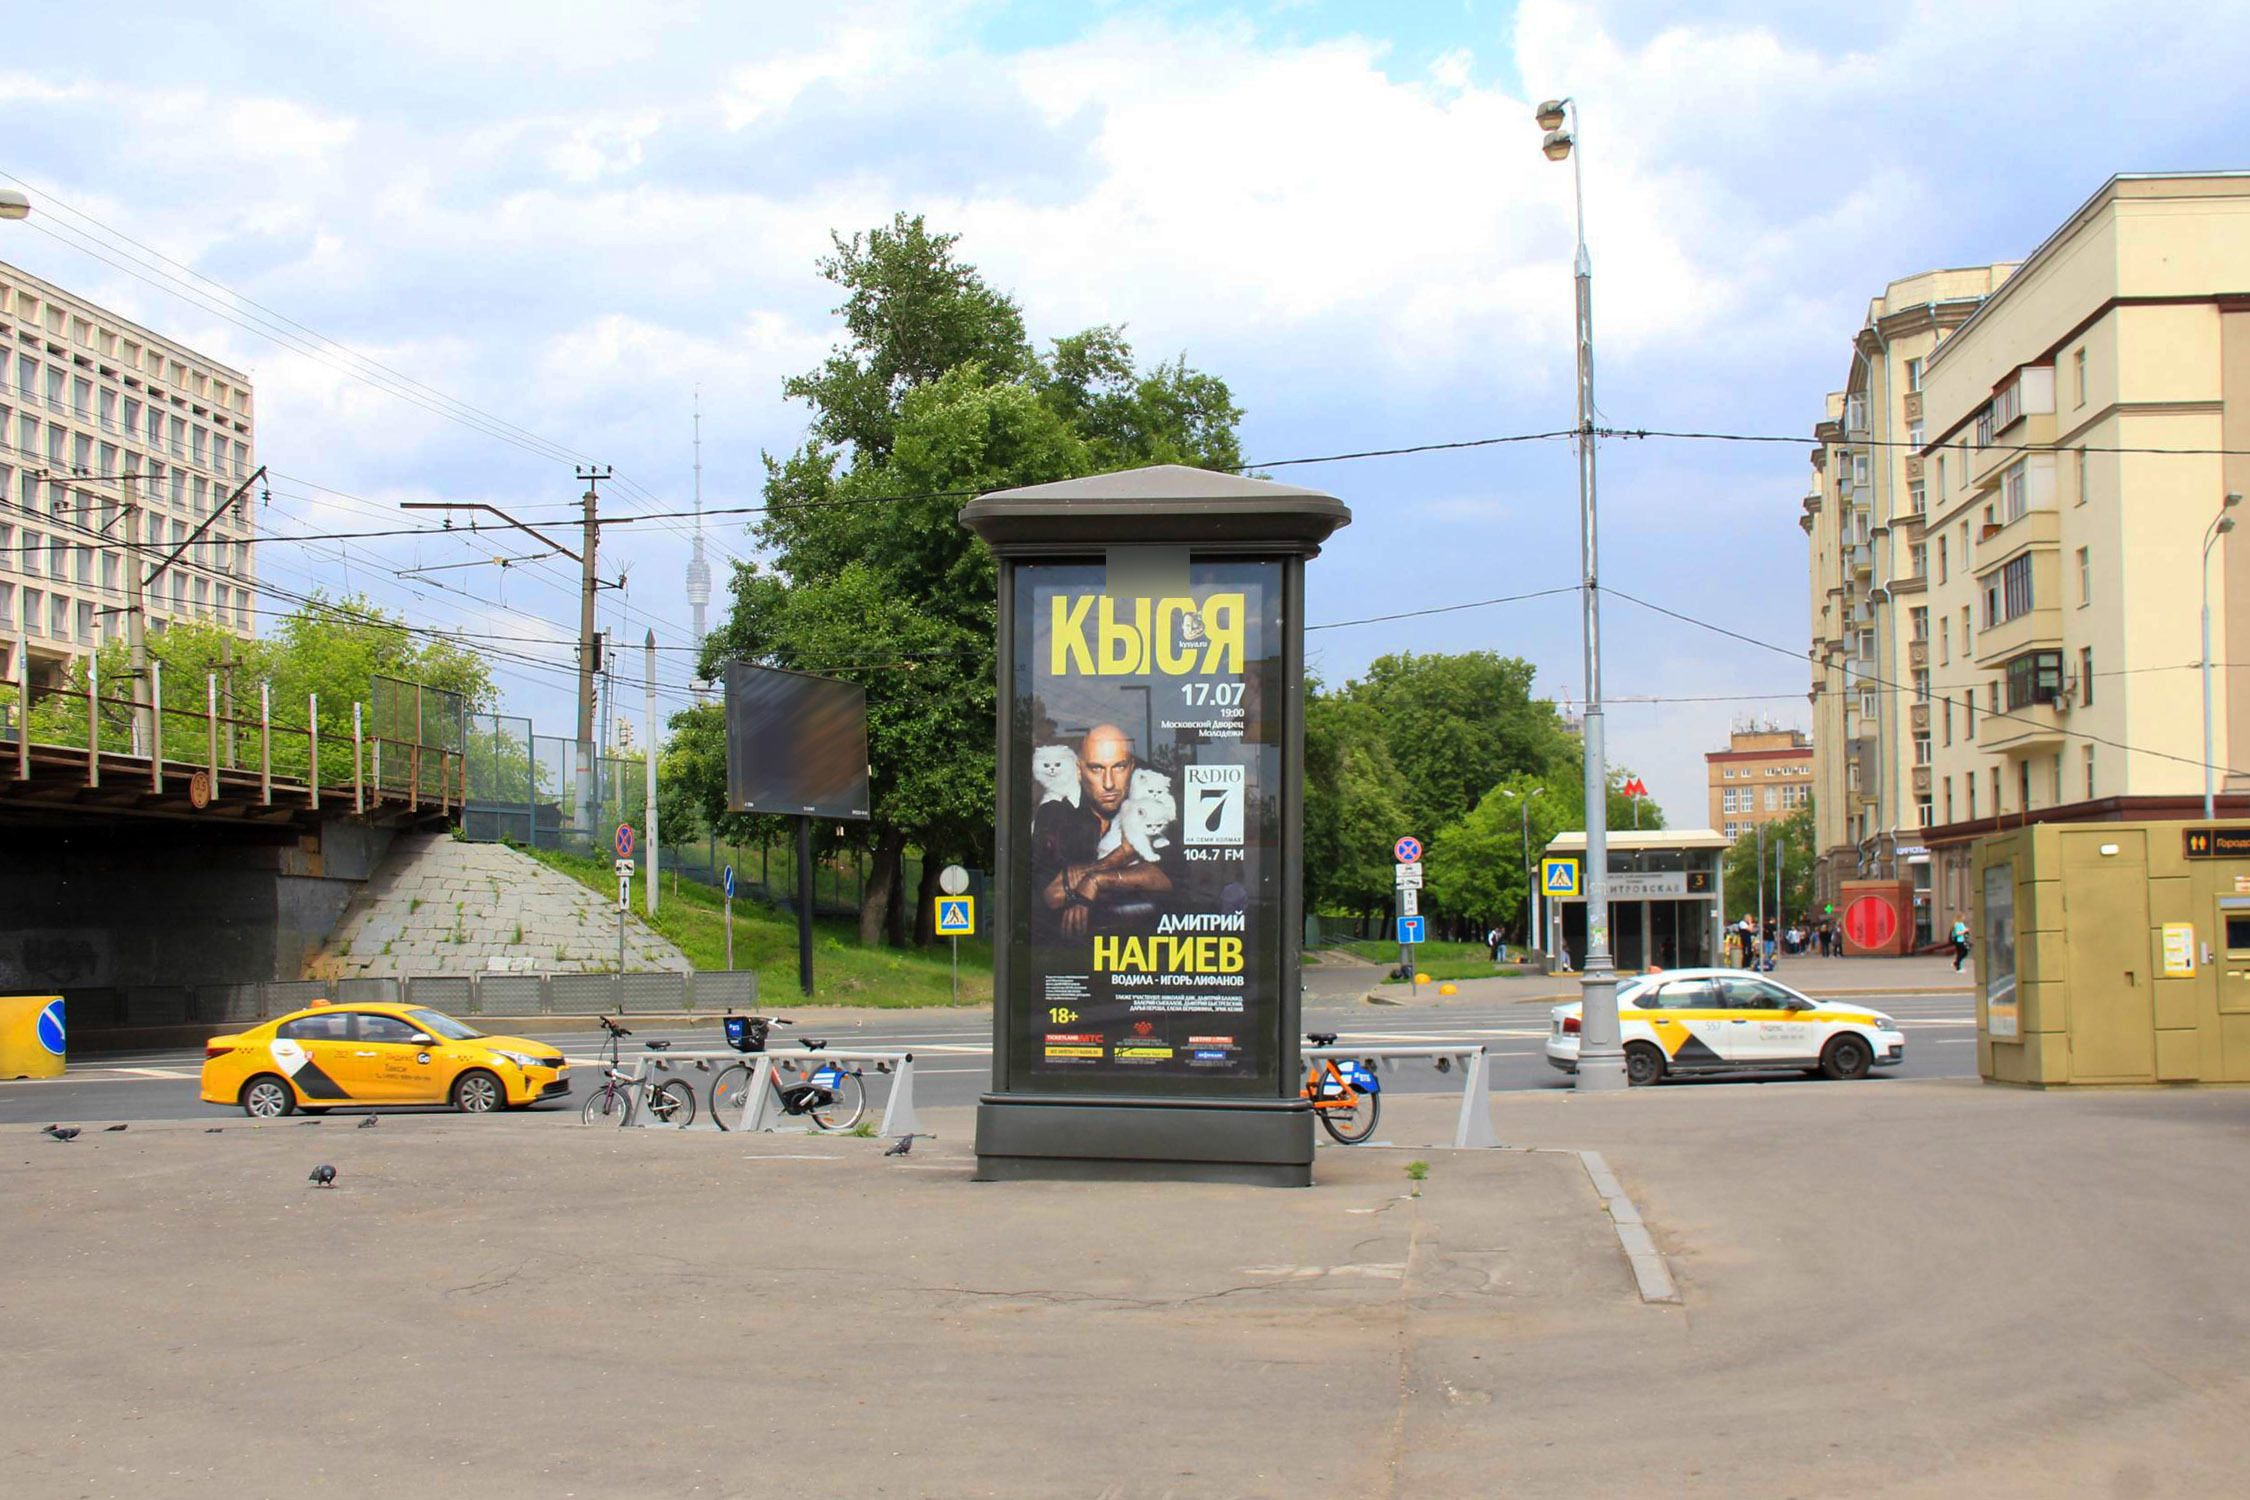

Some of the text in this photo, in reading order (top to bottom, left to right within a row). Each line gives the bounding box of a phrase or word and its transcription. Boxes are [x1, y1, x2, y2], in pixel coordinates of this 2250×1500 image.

[1051, 593, 1245, 676] КЫСЯ
[1179, 641, 1208, 649] kysya.ru
[1181, 683, 1245, 706] 17.07
[1220, 708, 1245, 717] 19:00
[1161, 720, 1244, 730] Московский Дворец
[1199, 729, 1243, 737] Молодежи
[1189, 769, 1241, 784] RADIO
[1200, 789, 1229, 832] 7
[1184, 849, 1244, 861] 104.7 FM
[1609, 884, 1680, 893] ИТРОВСКАЯ
[1157, 911, 1245, 934] ДМИТРИЙ
[1093, 936, 1244, 973] НАГИЕВ
[1111, 974, 1154, 987] ВОДИЛА
[1160, 975, 1192, 986] ИГОРЬ
[1193, 975, 1244, 987] ЛИФАНОВ
[1049, 1007, 1079, 1024] 18+
